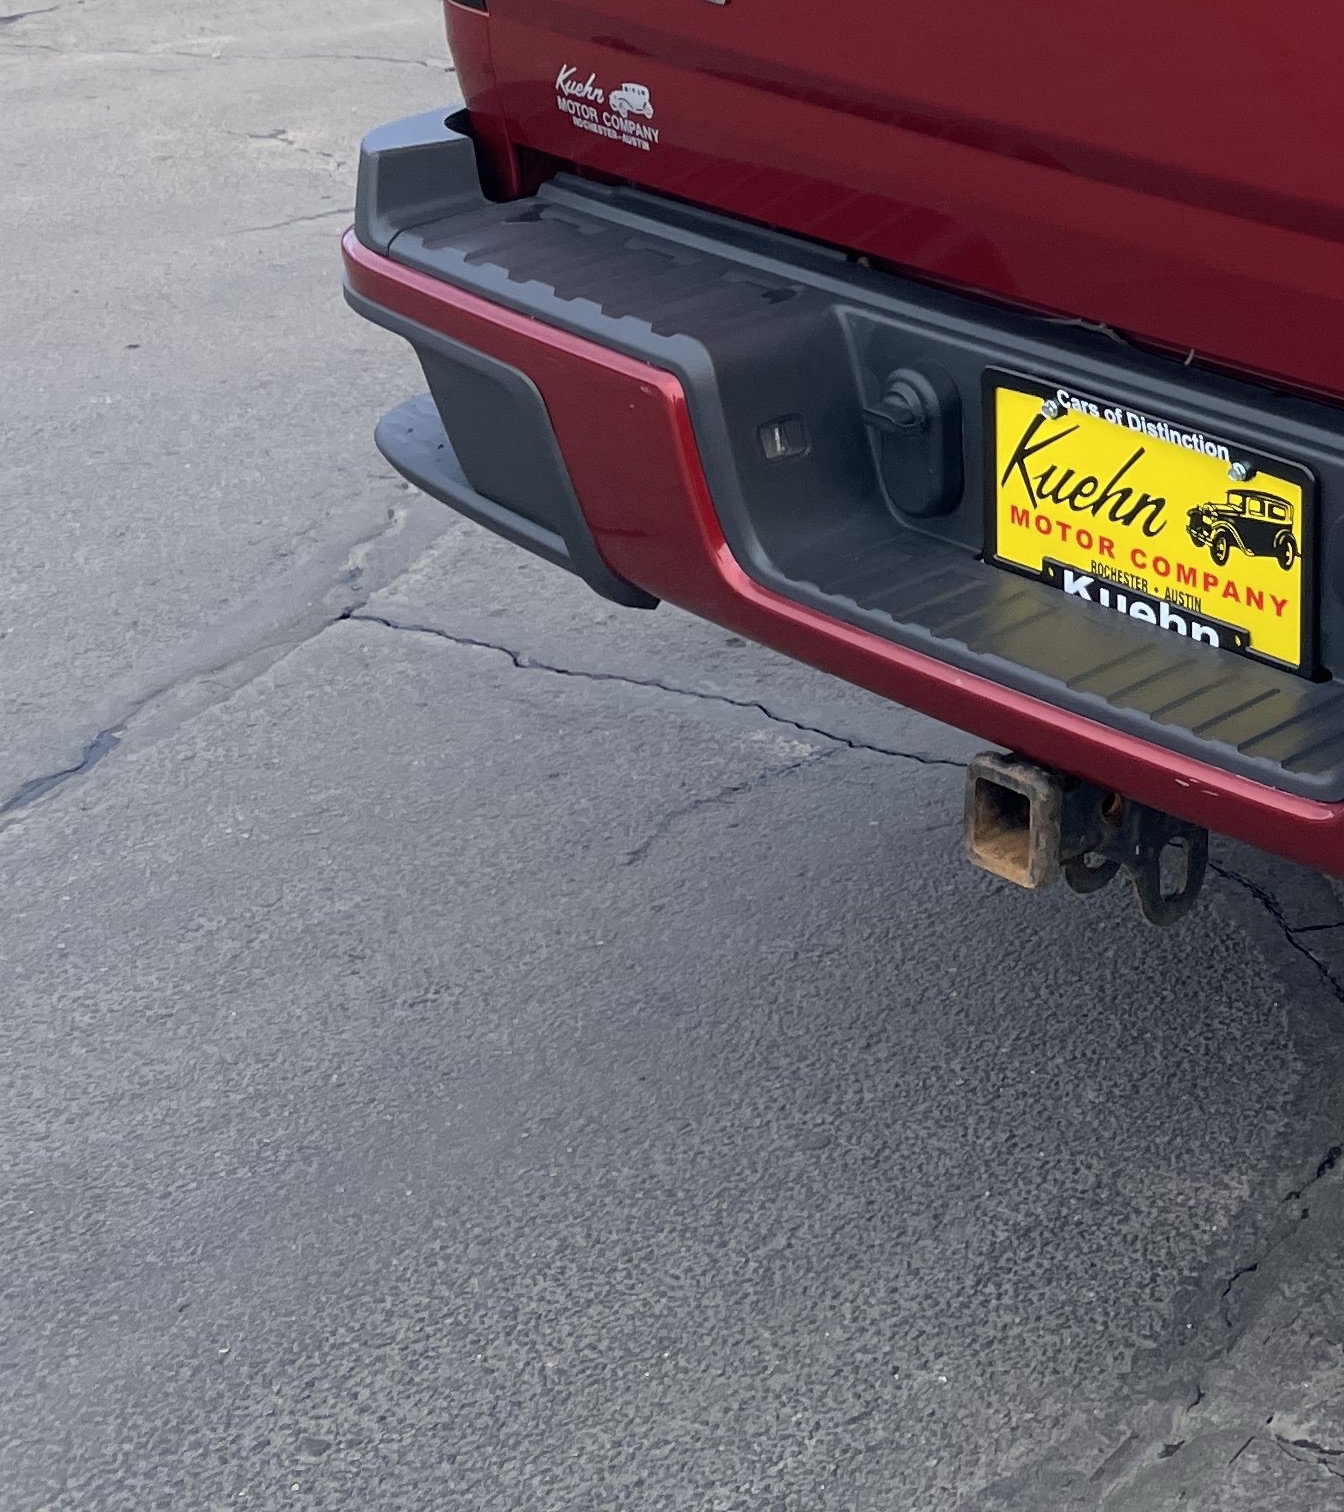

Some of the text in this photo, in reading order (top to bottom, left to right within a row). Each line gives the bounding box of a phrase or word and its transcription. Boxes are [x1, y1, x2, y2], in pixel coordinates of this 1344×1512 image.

[556, 63, 605, 105] Kuehn
[557, 95, 659, 145] MOTOR COMPANY
[1056, 389, 1230, 462] Cars of Distinction
[1001, 412, 1167, 538] Kuehn
[1010, 504, 1289, 618] MOTOR COMPANY
[1091, 560, 1203, 613] ROCHESTER AUSTIN
